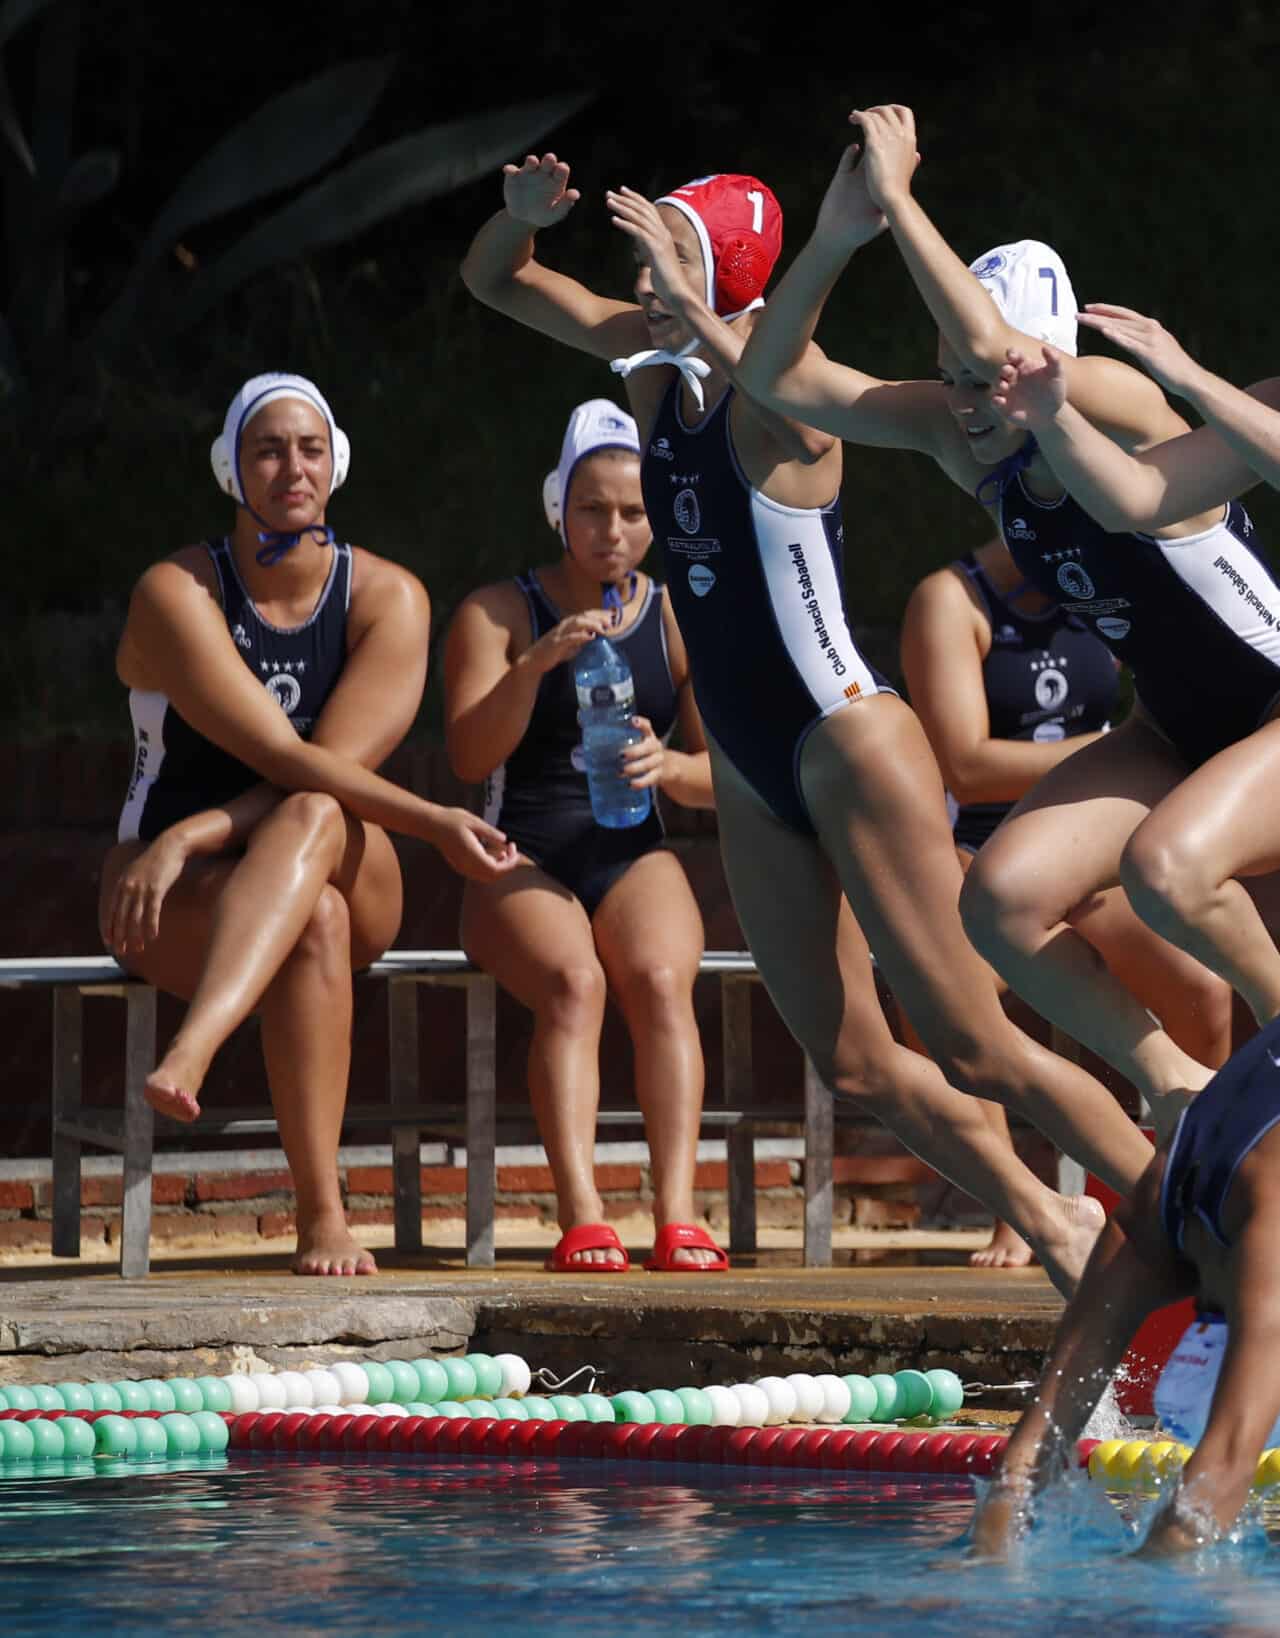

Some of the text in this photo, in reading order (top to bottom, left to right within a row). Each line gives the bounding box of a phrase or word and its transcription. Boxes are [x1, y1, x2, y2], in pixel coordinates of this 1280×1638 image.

[747, 191, 763, 234] 1
[1039, 267, 1058, 316] 7
[1213, 555, 1249, 596] Sabadell
[788, 543, 847, 676] Club Natació Sabadell
[1244, 589, 1277, 626] Natació
